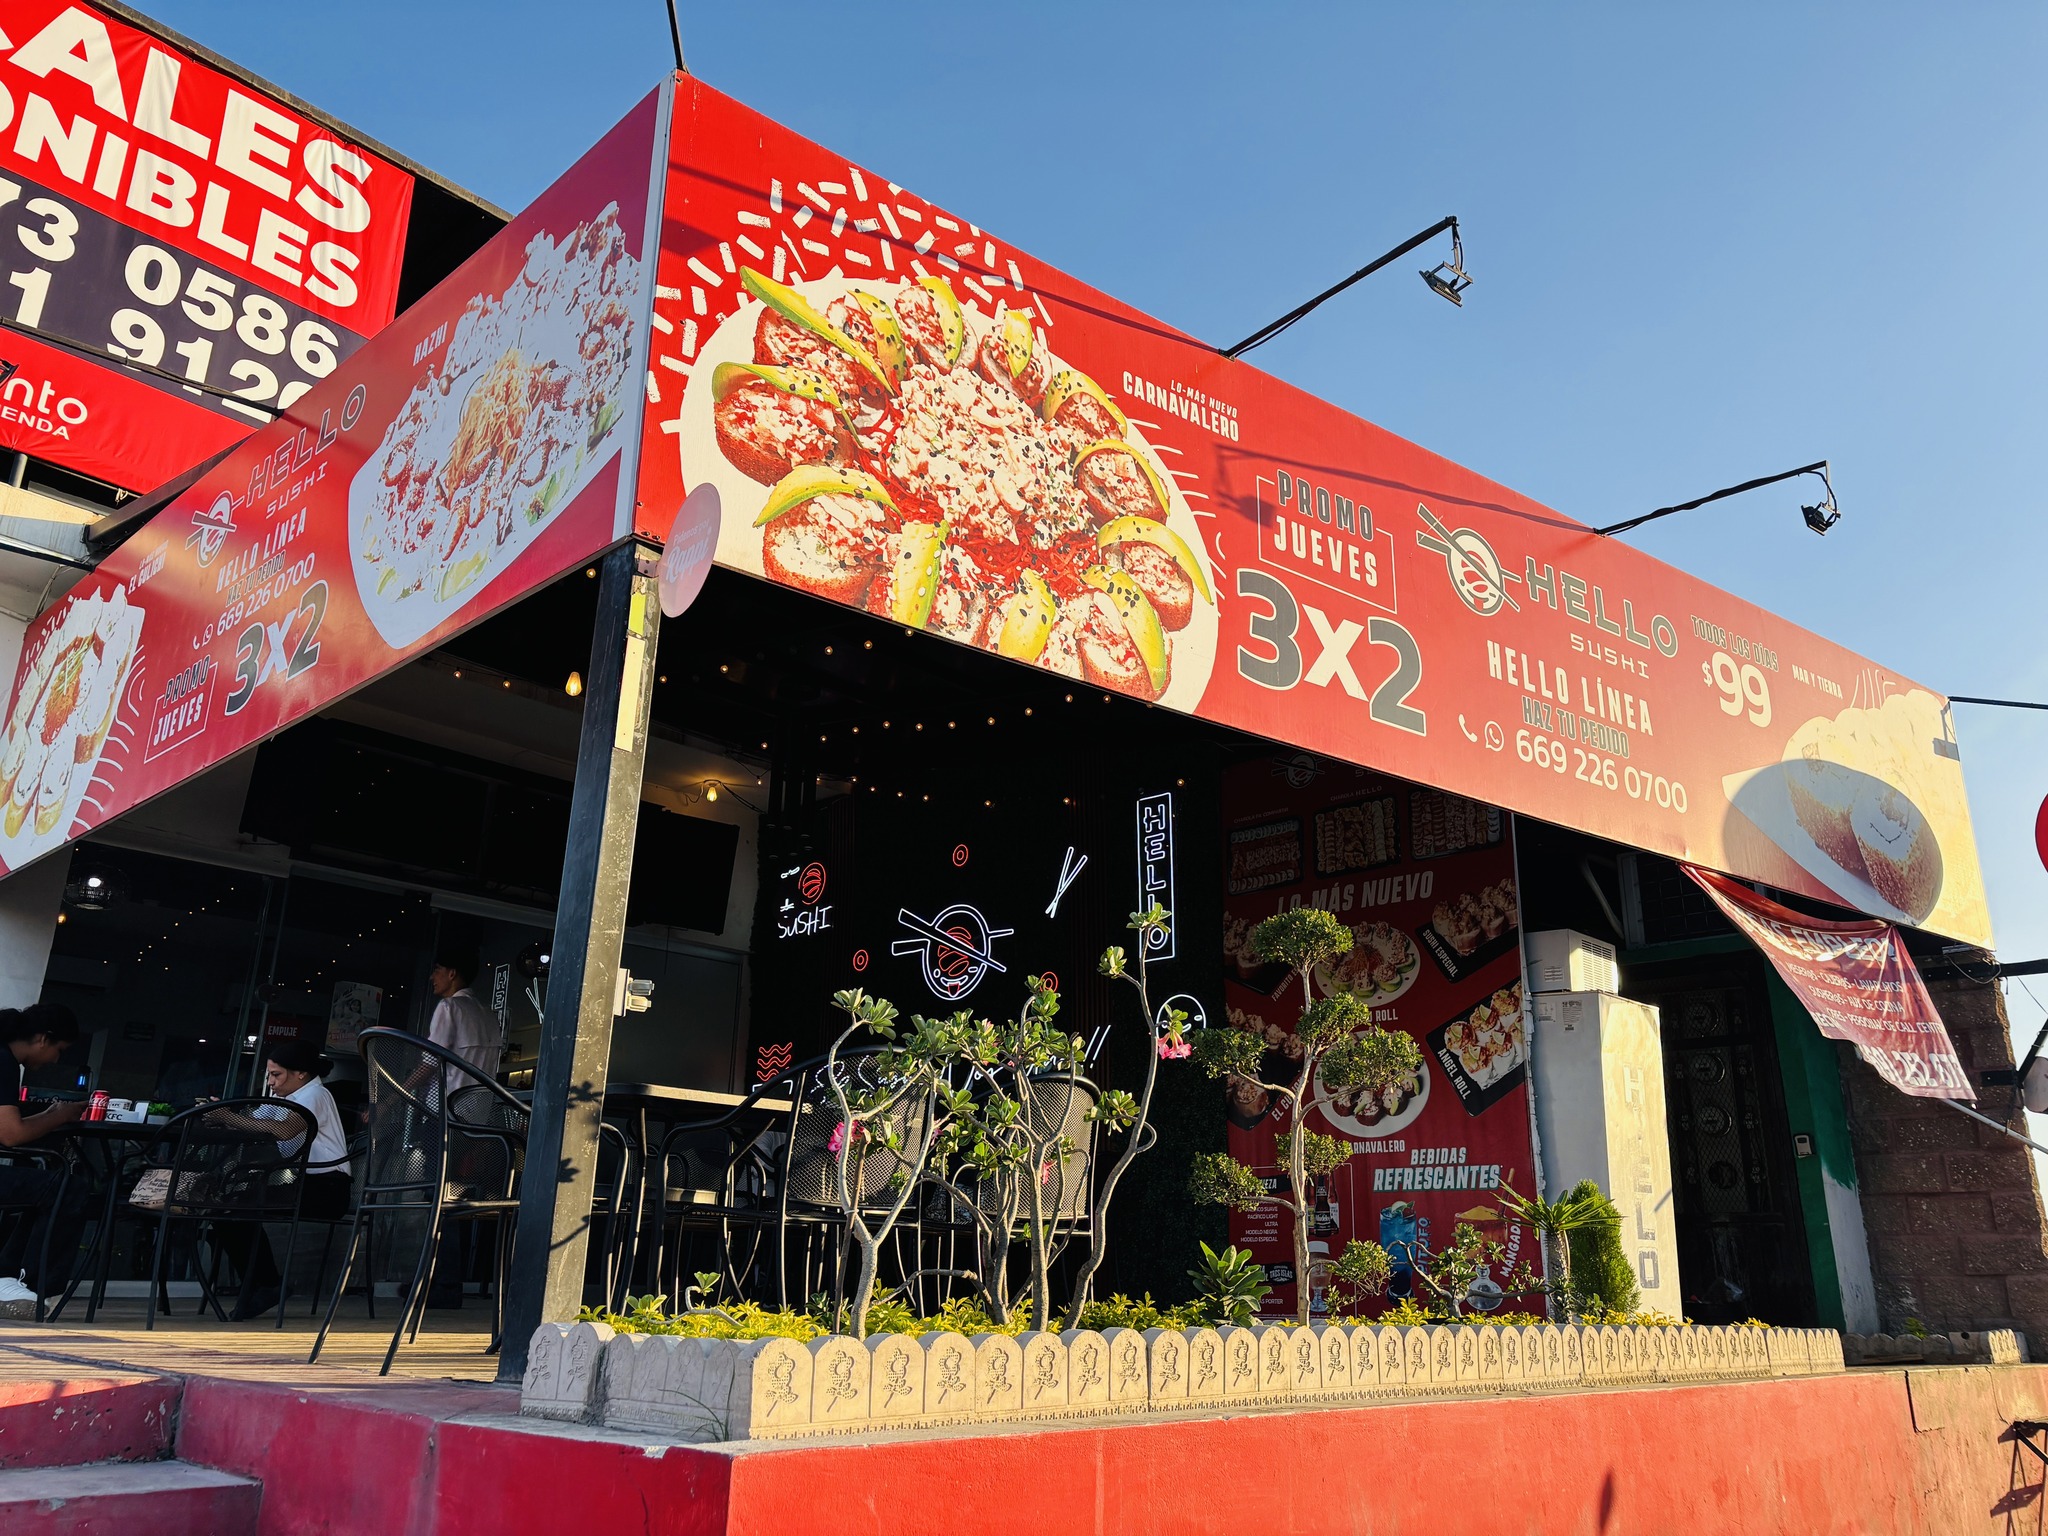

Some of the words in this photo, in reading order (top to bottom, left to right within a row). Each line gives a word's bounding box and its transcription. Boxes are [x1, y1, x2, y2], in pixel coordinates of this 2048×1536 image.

[0, 6, 373, 233] ALES
[0, 80, 360, 307] NIBLES
[124, 244, 338, 378] 0586
[413, 321, 448, 367] HAZHI
[3, 378, 88, 424] nto
[1123, 370, 1239, 442] CARNAVALERO
[1209, 397, 1238, 418] NUEVO
[247, 384, 366, 508] HELLO
[266, 461, 328, 519] SUSHI
[1277, 468, 1375, 542] PROMO
[216, 542, 259, 593] HELLO
[1273, 515, 1378, 588] JUEVES
[217, 601, 244, 636] 669
[245, 582, 272, 618] 226
[274, 553, 315, 598] 0700
[226, 579, 244, 608] HAZ
[244, 570, 257, 595] TU
[255, 549, 286, 587] PEDIDO
[1525, 555, 1679, 659] HELLO
[1570, 633, 1650, 679] SUSHI
[1691, 614, 1727, 650] TODOS
[1729, 632, 1751, 660] LOS
[1753, 642, 1779, 673] DÍAS
[163, 655, 210, 709] PROMO
[1487, 639, 1570, 706] HELLO
[1581, 676, 1653, 736] LÍNEA
[1701, 651, 1772, 728] $99
[1792, 664, 1810, 686] MAR
[1810, 672, 1817, 687] Y
[1817, 675, 1843, 700] TIERRA
[153, 693, 204, 746] JUEVES
[1522, 695, 1554, 733] HAZ
[1556, 707, 1576, 741] TU
[1579, 716, 1630, 759] PEDIDO
[1515, 728, 1568, 774] 669
[1573, 748, 1619, 791] 226
[1624, 765, 1688, 814] 0700
[1361, 870, 1434, 909] NUEVO
[1422, 929, 1438, 949] SUSHI
[1435, 945, 1459, 978] ESPECIAL
[1271, 976, 1294, 1002] FAVORITO
[1375, 1008, 1398, 1022] ROLL
[267, 1025, 298, 1037] EMPUJE
[1895, 1021, 1917, 1033] CALL
[1437, 1048, 1458, 1078] ANGEL
[1453, 1075, 1471, 1100] ROLL
[105, 1113, 123, 1121] KFC
[1271, 1107, 1284, 1122] EL
[1349, 1139, 1406, 1155] ARNAVALERO
[1410, 1146, 1467, 1165] BEBIDAS
[1373, 1164, 1500, 1192] REFRESCANTES
